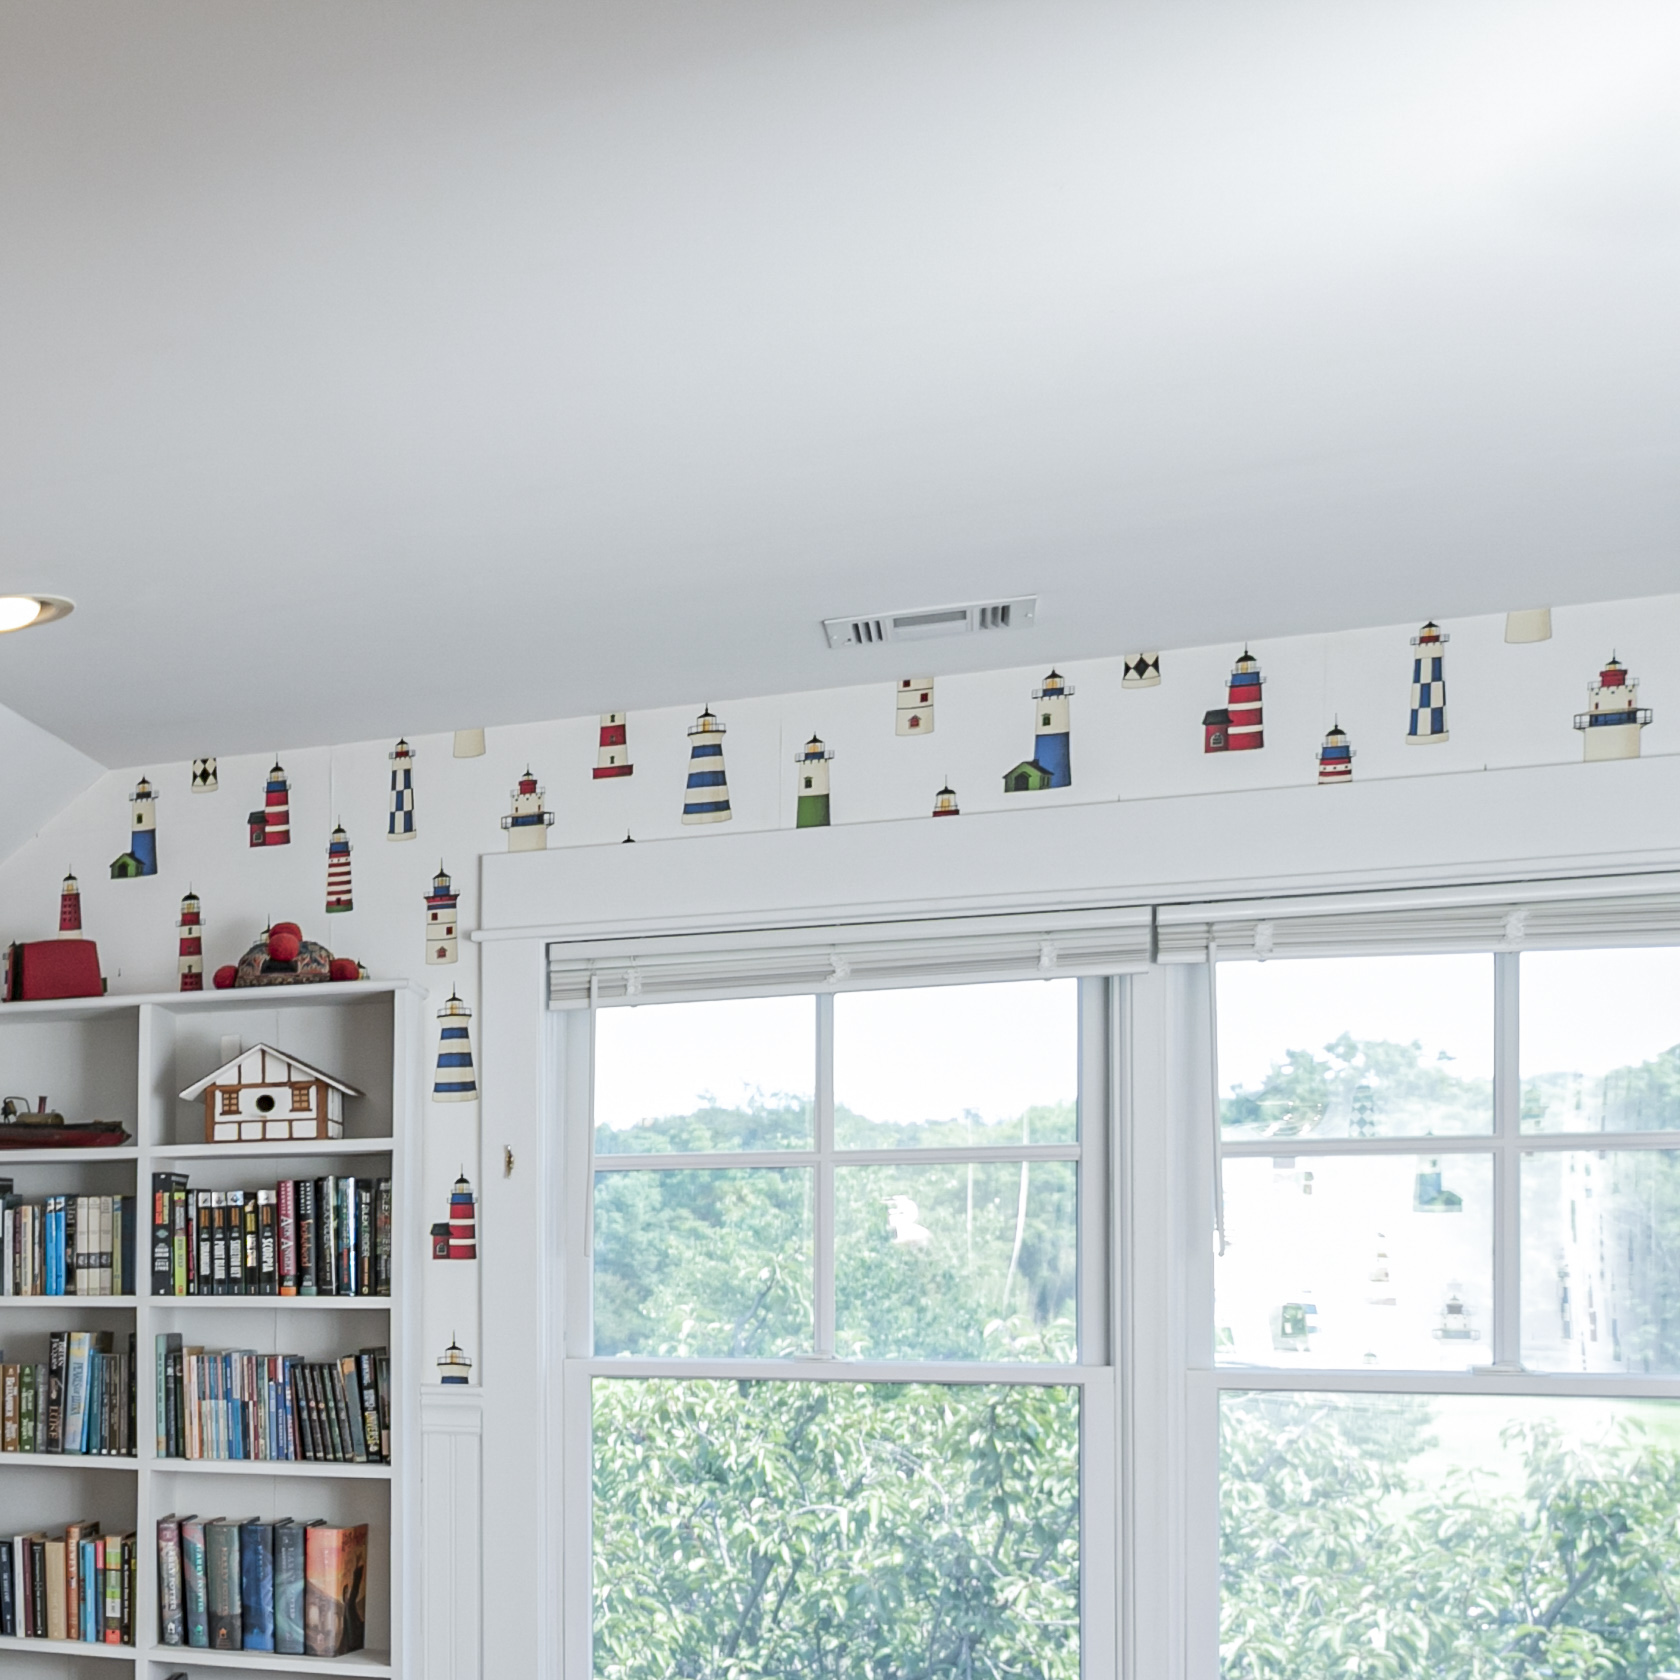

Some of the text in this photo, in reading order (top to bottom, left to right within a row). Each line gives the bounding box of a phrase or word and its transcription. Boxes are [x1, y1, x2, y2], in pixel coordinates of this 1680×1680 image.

[262, 1238, 274, 1272] SCORPIA
[49, 1406, 59, 1439] LUKE
[365, 1411, 379, 1444] UNIVERSE
[168, 1541, 177, 1610] HARRY POTTER
